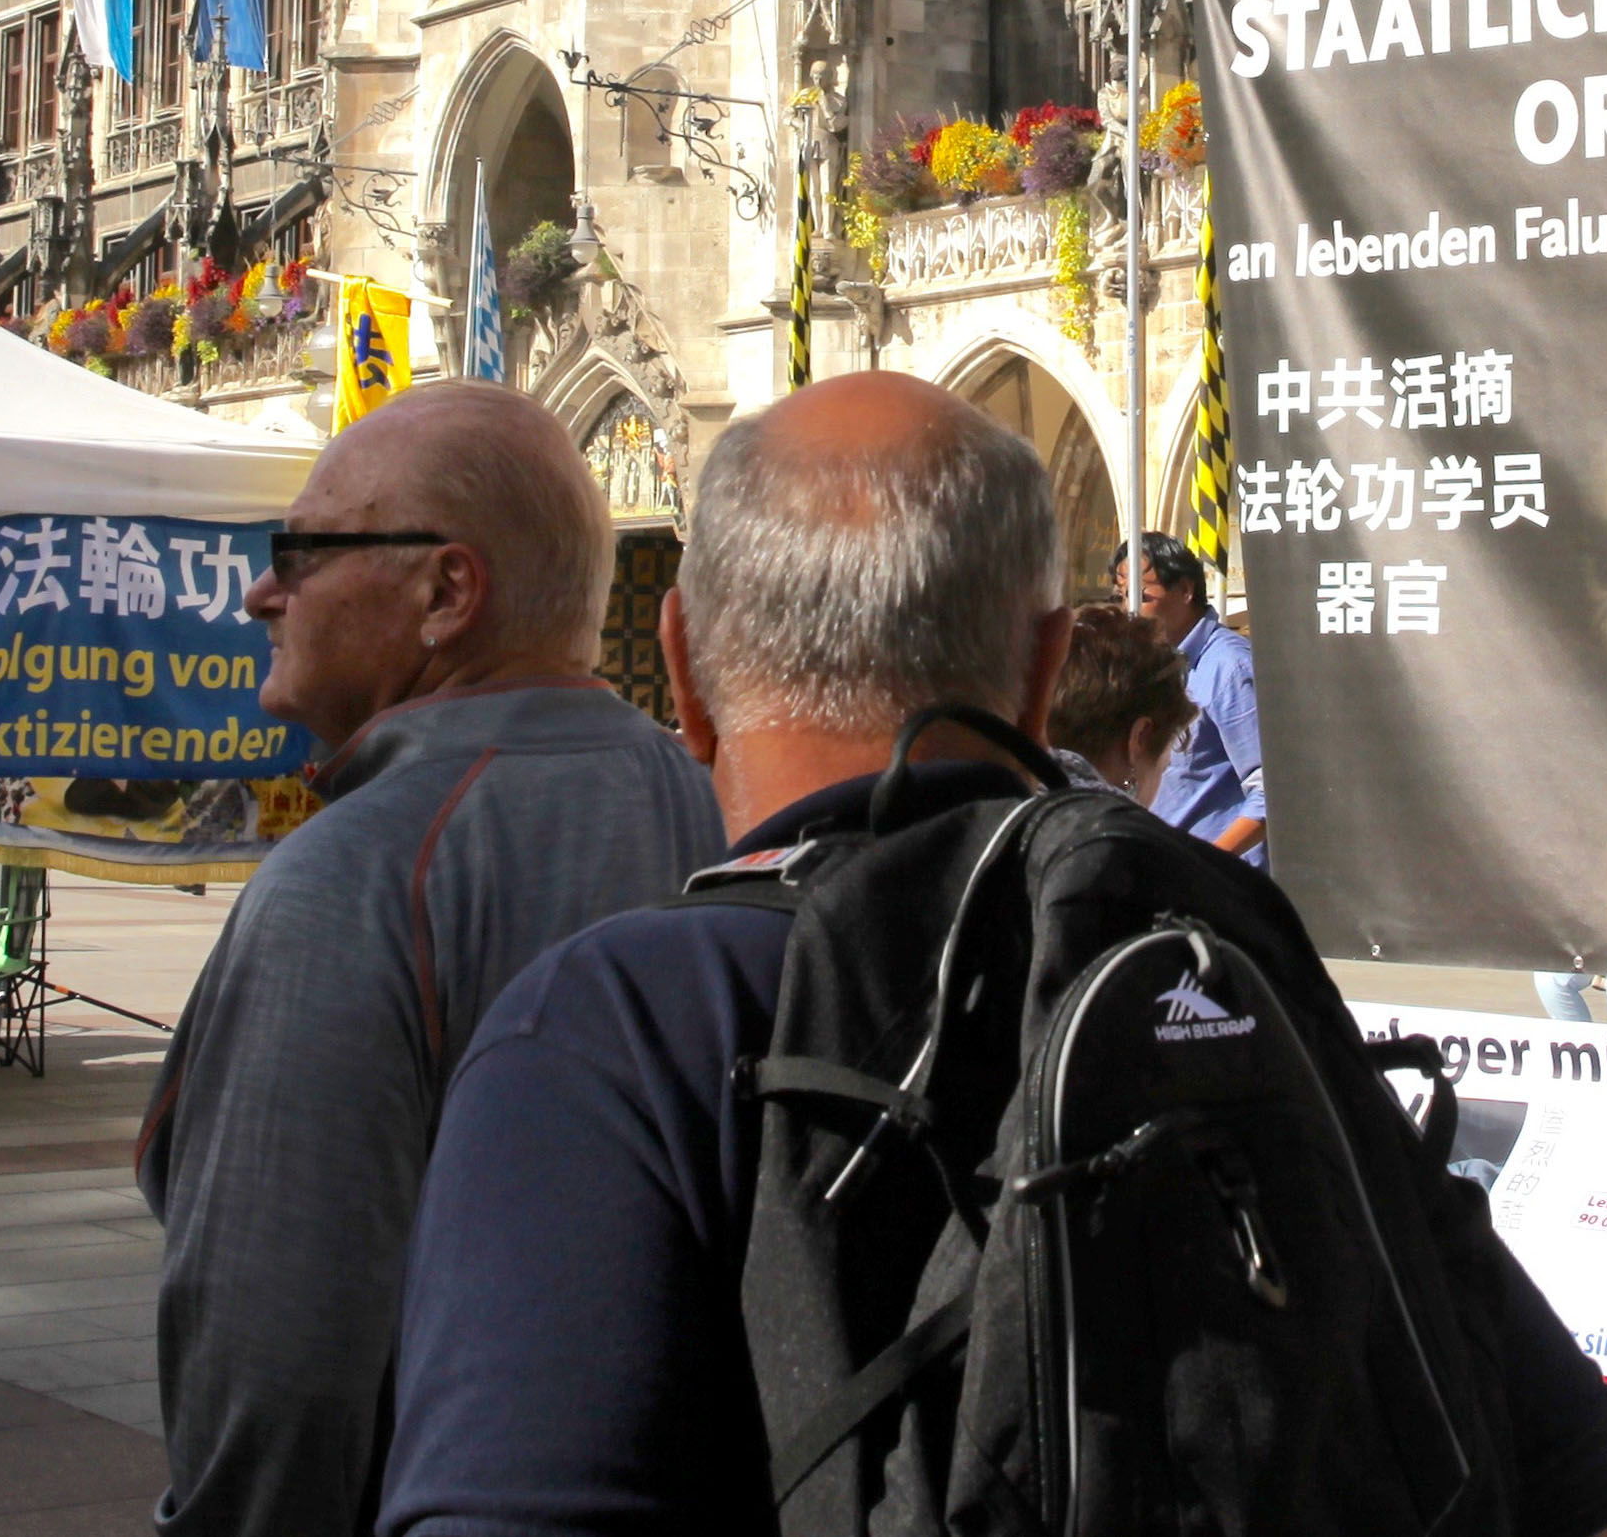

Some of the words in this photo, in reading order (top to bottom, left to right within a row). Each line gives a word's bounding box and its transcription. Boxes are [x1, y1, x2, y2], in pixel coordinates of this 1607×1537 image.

[1229, 240, 1278, 283] an
[1295, 213, 1496, 277] lebenden
[1257, 348, 1514, 434] 中共活摘
[1237, 453, 1550, 535] 法轮功学员
[1316, 559, 1447, 634] 器官
[171, 654, 255, 689] von
[1154, 1024, 1192, 1041] HIGH
